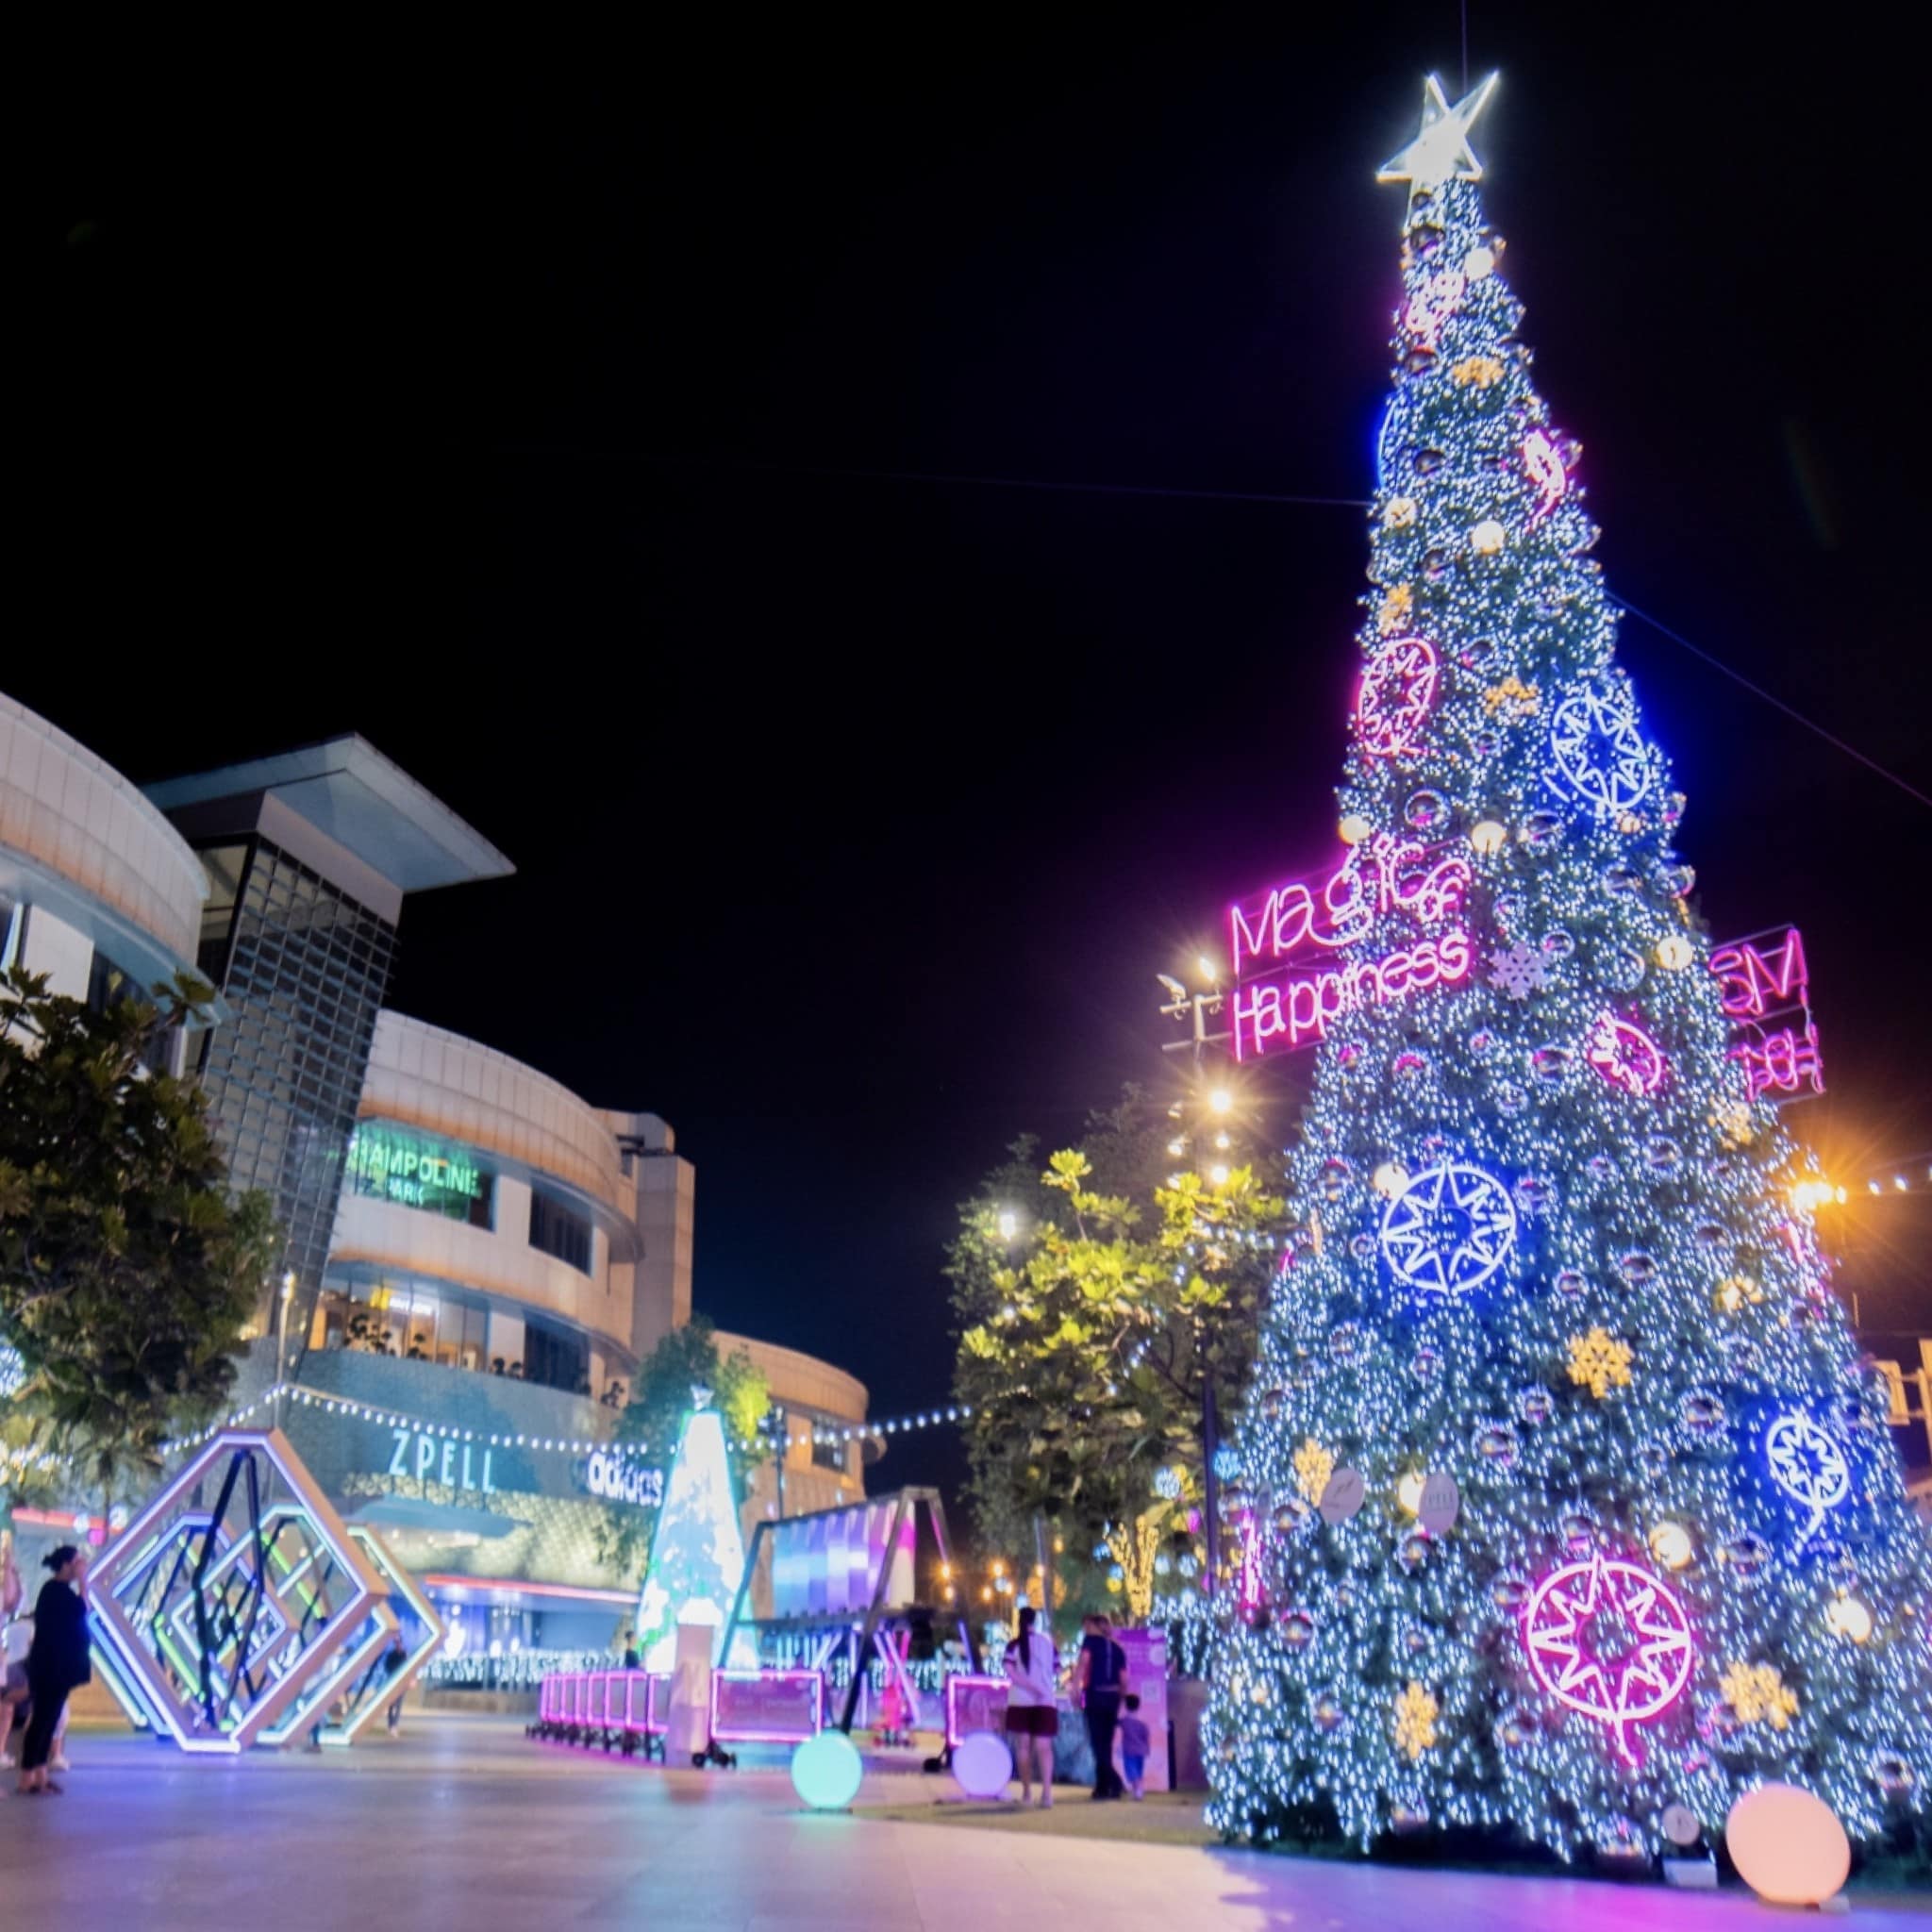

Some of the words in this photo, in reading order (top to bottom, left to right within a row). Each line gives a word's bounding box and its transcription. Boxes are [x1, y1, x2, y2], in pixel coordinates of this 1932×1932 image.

[1231, 832, 1469, 976] Magic
[1232, 932, 1470, 1064] Happiness
[389, 1428, 496, 1494] ZPELL
[588, 1452, 664, 1507] adidas
